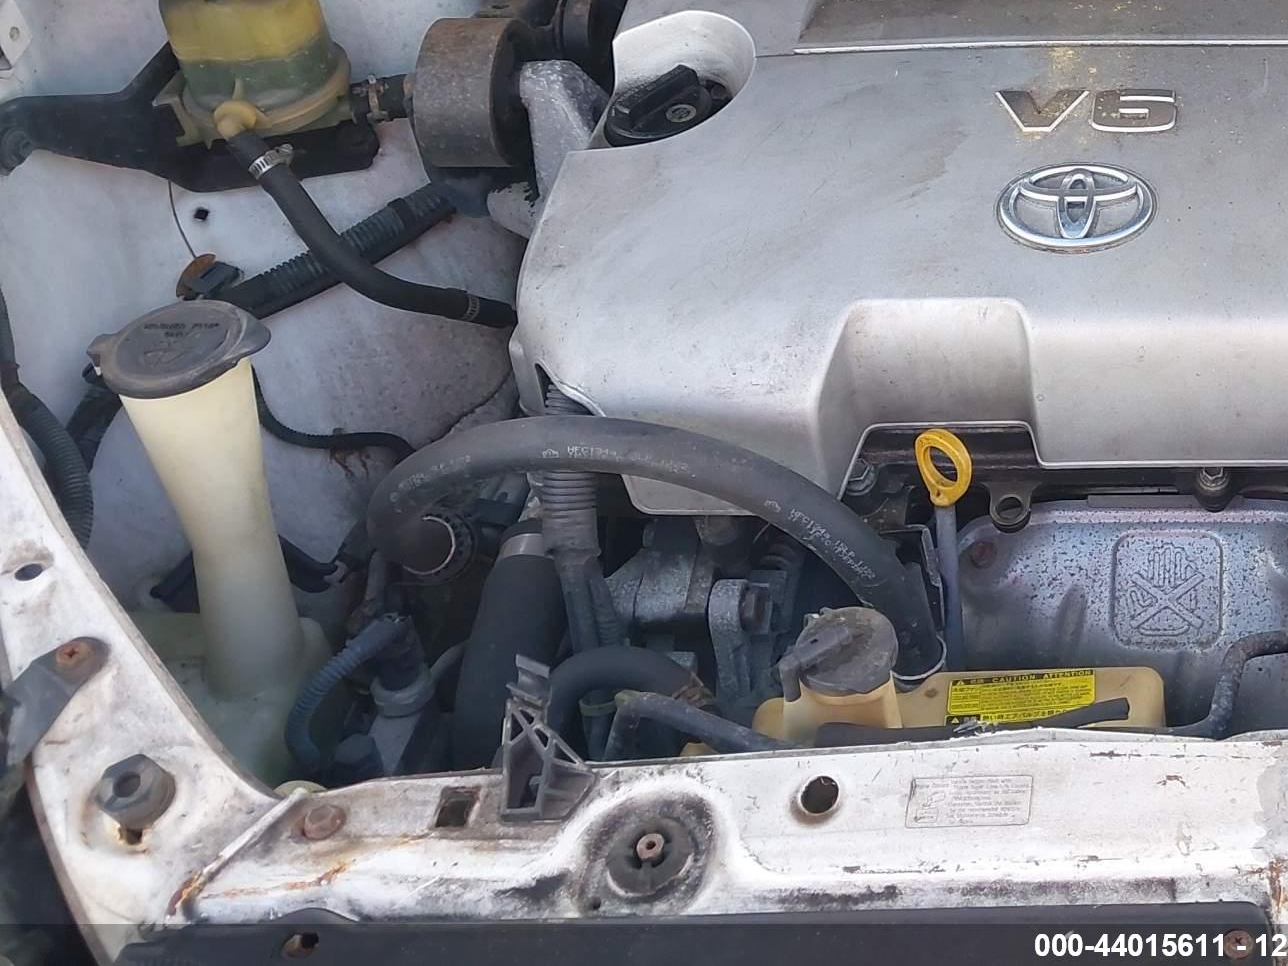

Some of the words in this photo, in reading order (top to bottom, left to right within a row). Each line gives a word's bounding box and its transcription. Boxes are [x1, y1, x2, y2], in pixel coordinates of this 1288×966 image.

[995, 89, 1178, 132] V6
[992, 674, 1036, 683] CAUTION
[1043, 670, 1092, 679] ATTENTION
